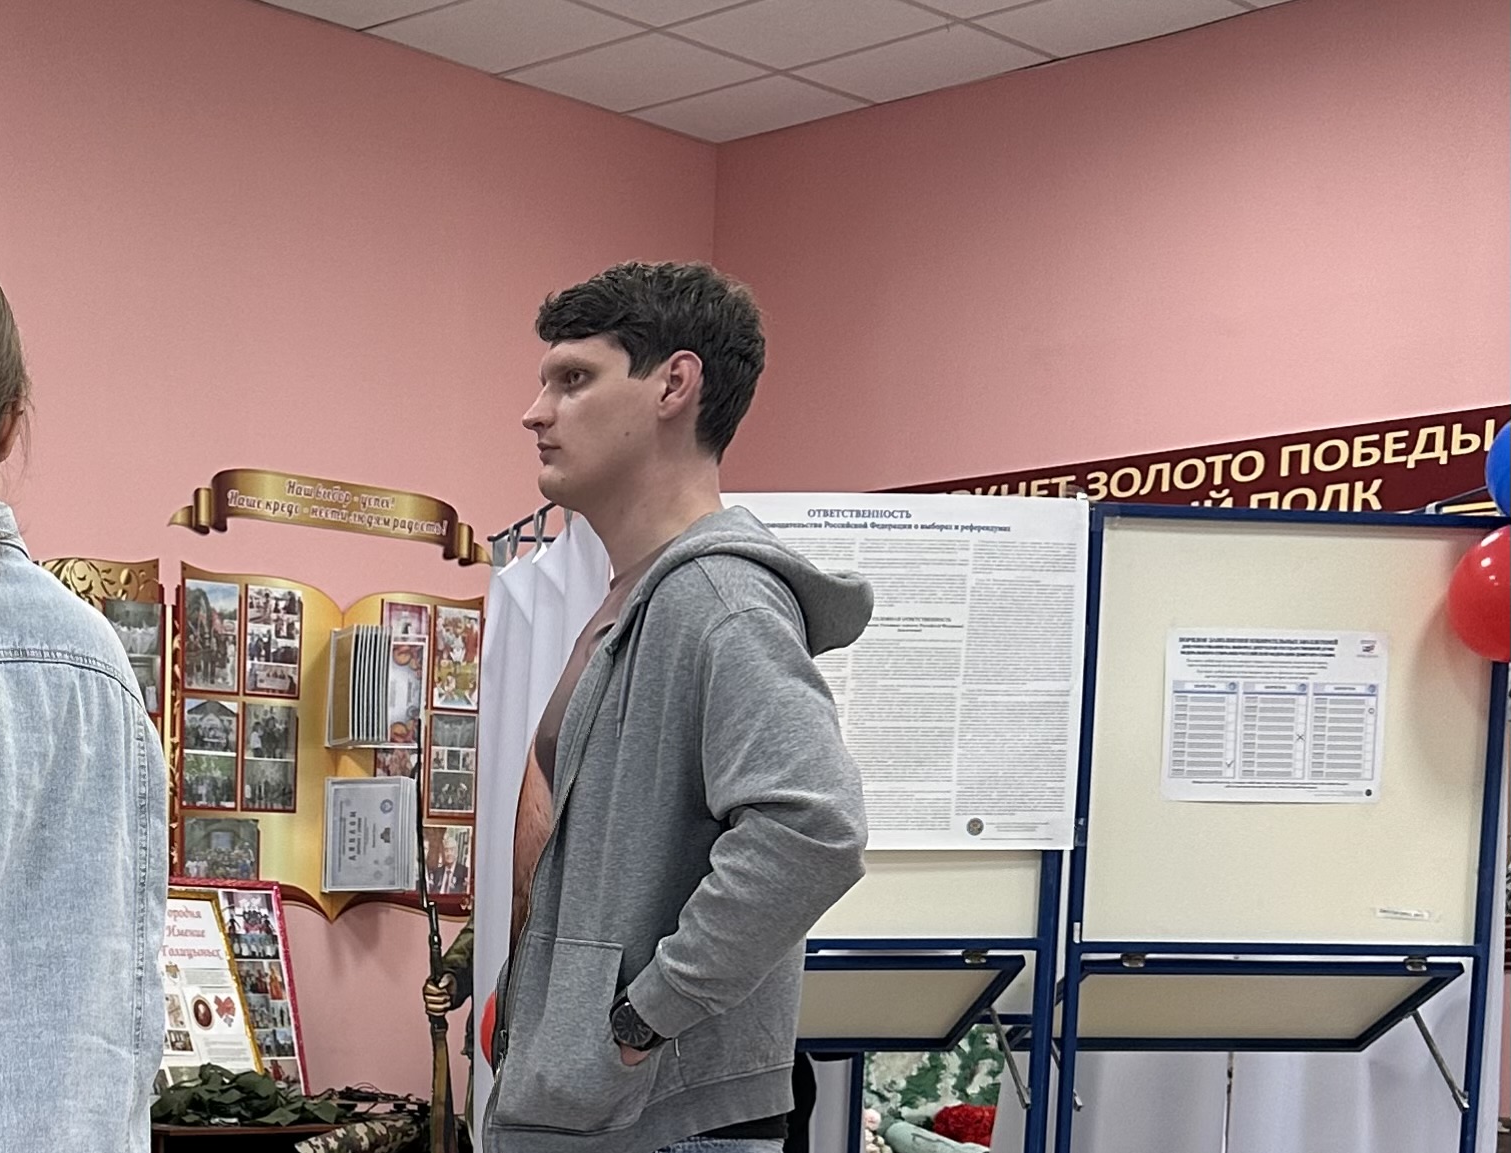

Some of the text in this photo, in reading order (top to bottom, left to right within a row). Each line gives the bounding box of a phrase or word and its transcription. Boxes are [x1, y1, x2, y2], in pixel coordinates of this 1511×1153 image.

[1086, 450, 1266, 501] ЗОЛОТО
[1280, 419, 1494, 474] ПОБЕДЫ
[228, 489, 262, 510] Наше
[286, 480, 313, 498] Наш
[1248, 479, 1384, 512] ПОЛК
[807, 508, 912, 519] ОТВЕТСТВЕННОСТЬ
